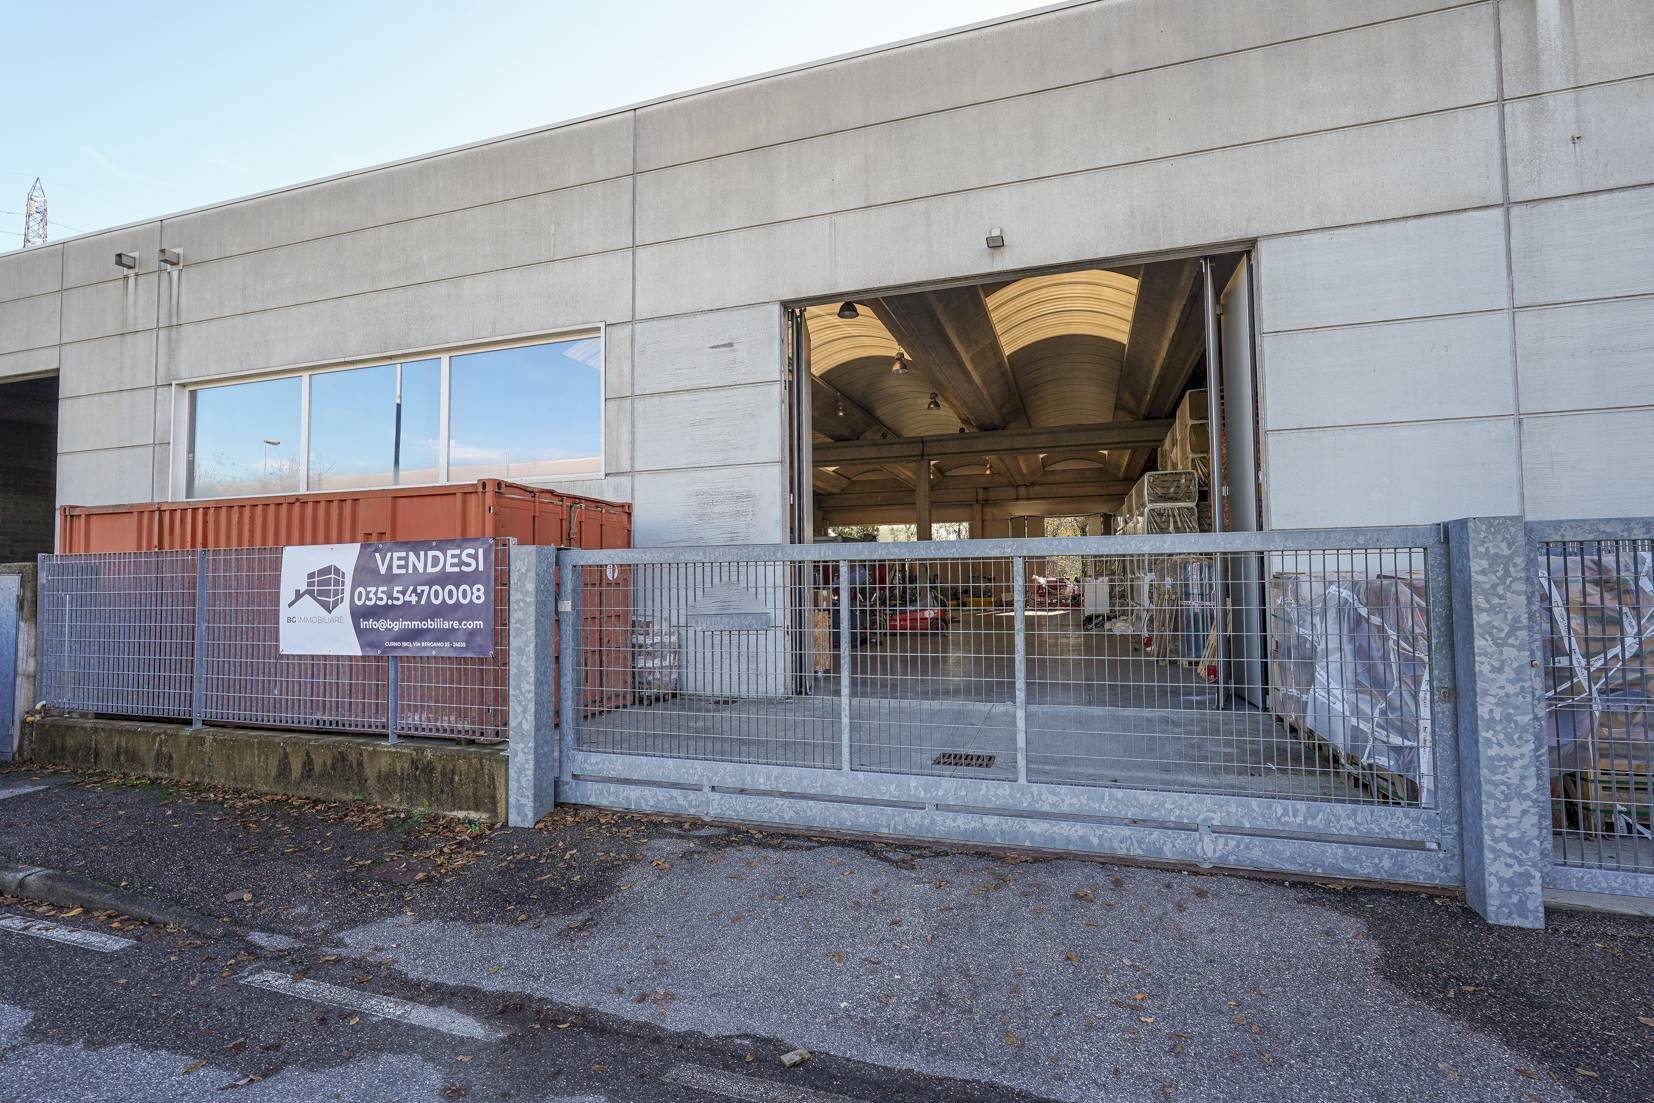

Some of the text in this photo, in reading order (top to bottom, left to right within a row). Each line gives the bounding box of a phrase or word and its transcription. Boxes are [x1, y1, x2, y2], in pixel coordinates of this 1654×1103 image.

[375, 548, 484, 574] VENDESI
[354, 584, 485, 606] 035.5470008
[286, 616, 344, 624] BG IMMOBILIARE
[360, 618, 484, 631] info@bgimmobiliare.com
